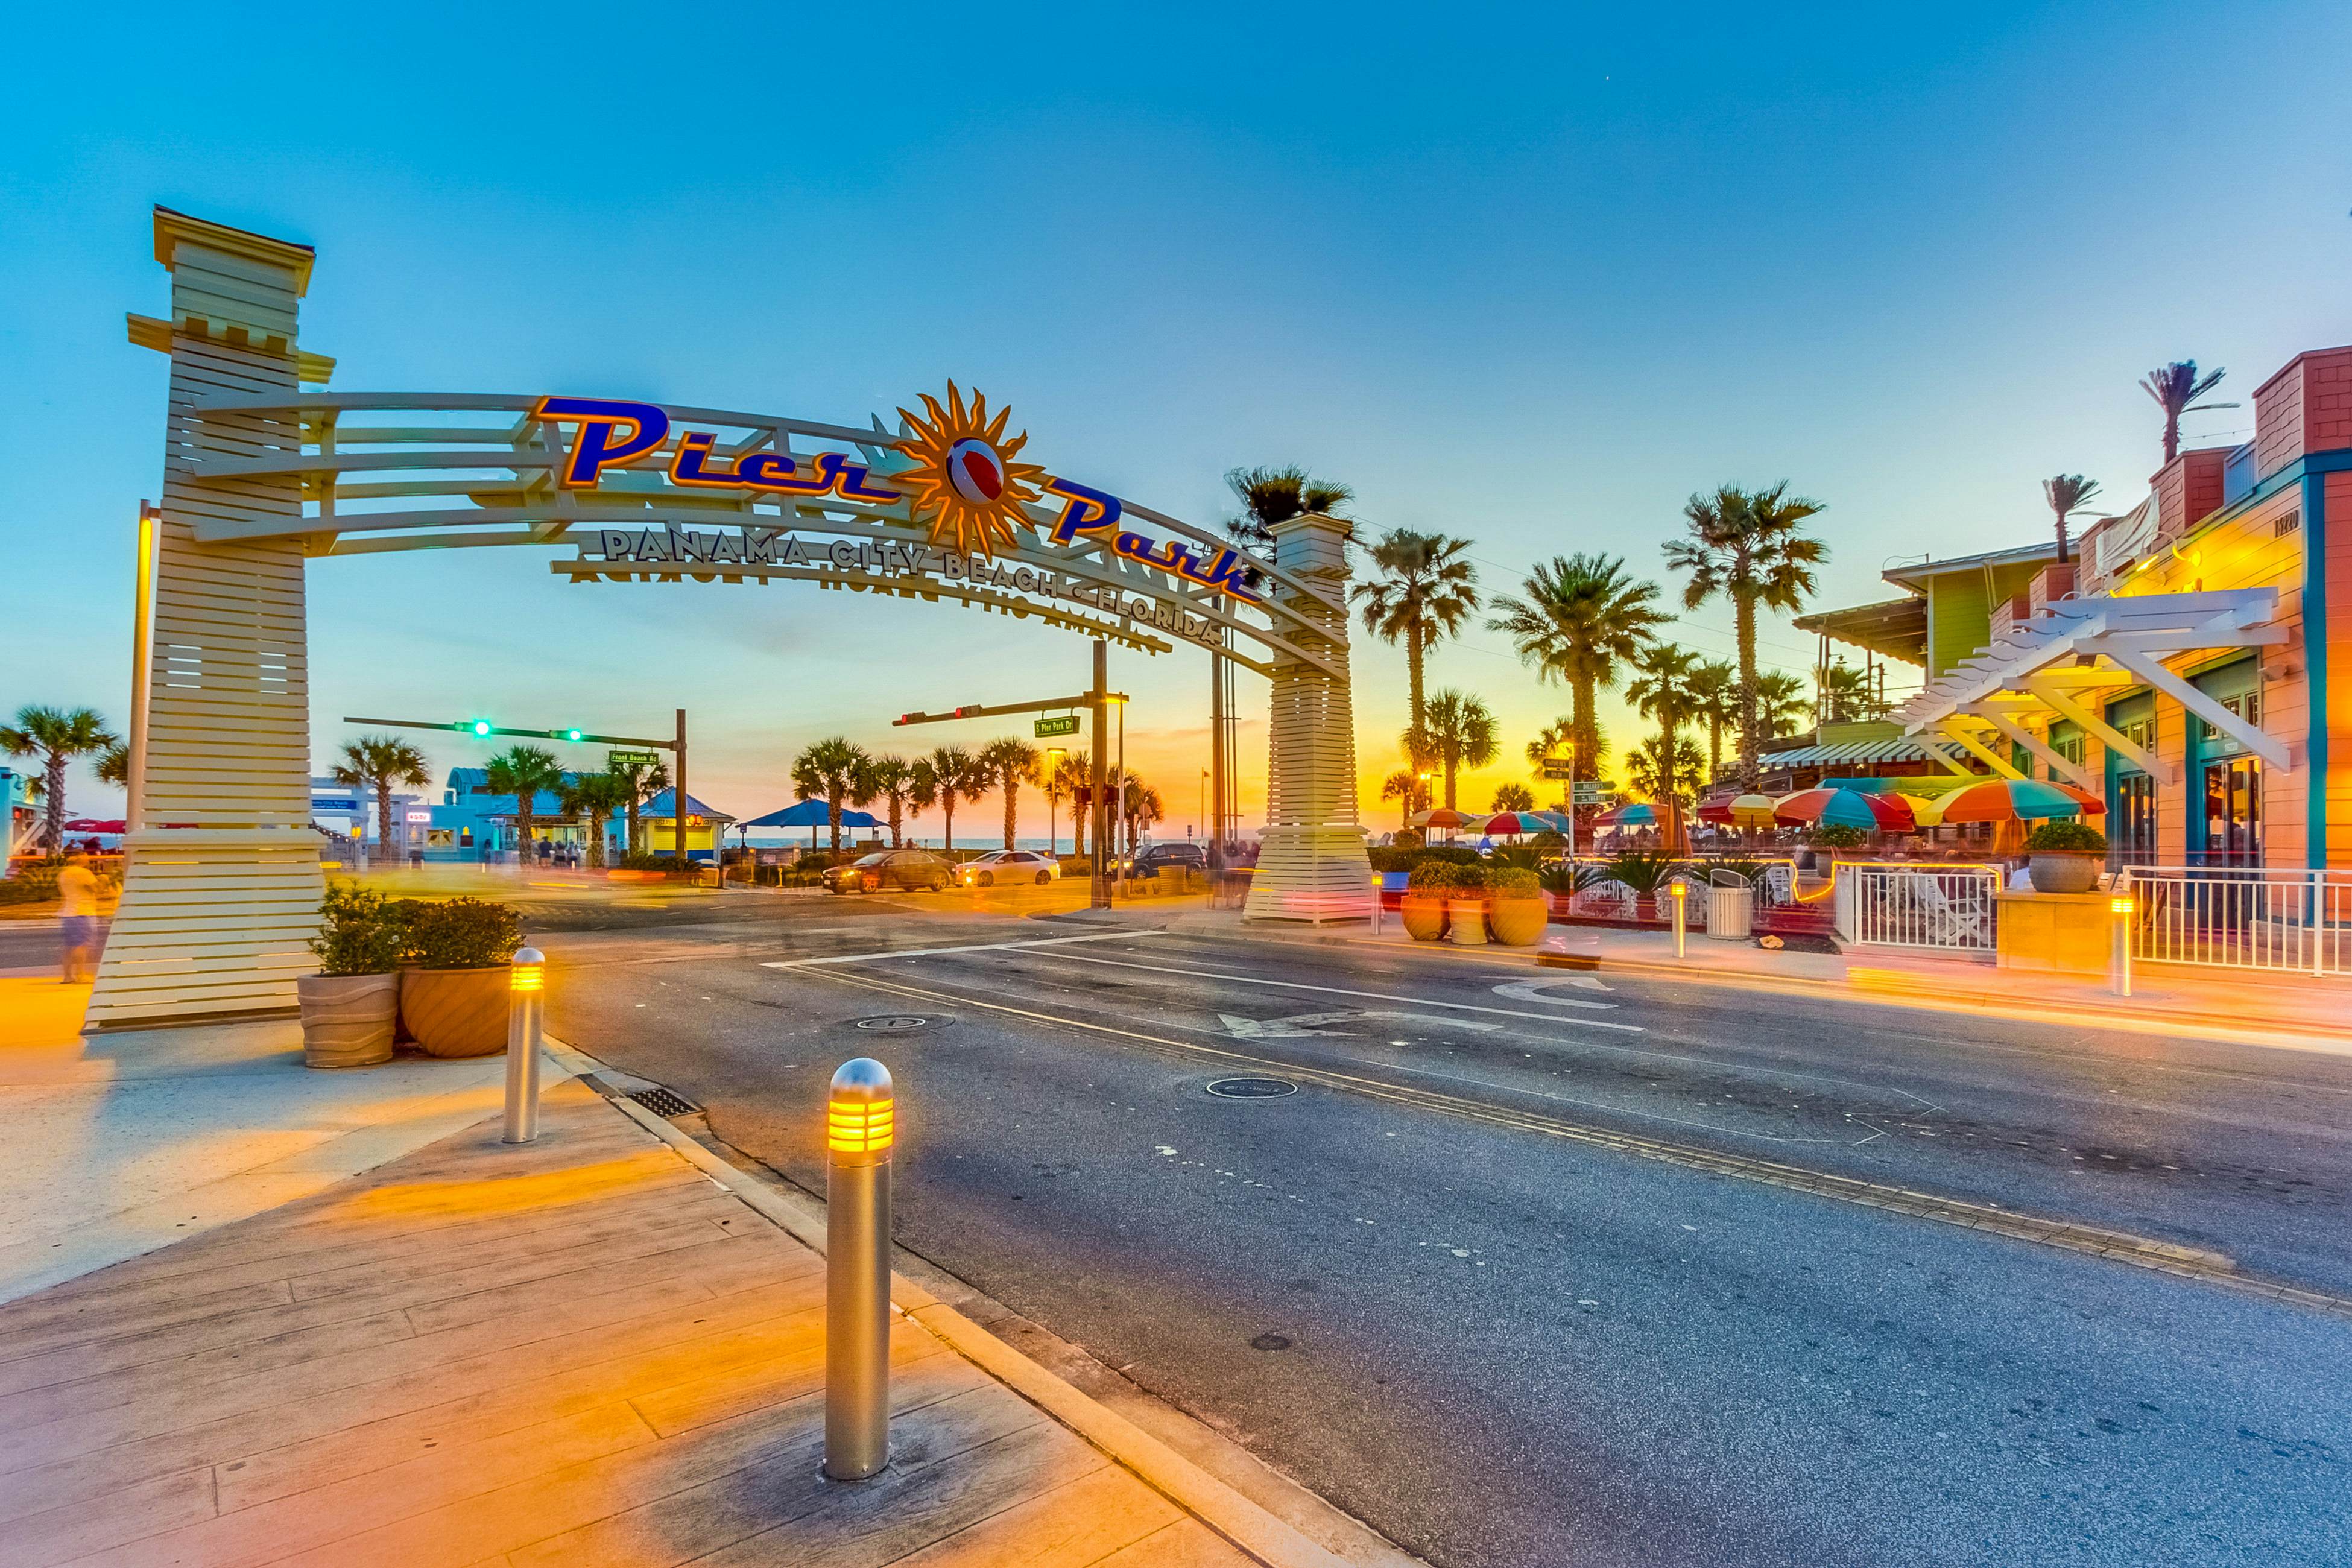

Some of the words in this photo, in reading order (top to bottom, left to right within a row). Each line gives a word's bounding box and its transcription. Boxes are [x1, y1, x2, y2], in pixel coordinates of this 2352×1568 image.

[526, 395, 902, 505] Pier
[1040, 475, 1263, 605] Park
[2275, 509, 2300, 539] 16220
[600, 526, 811, 566] PANAMA
[829, 540, 926, 575] CITY
[943, 551, 1058, 598] BEACH
[1097, 585, 1218, 646] FLORIDA
[1036, 724, 1040, 733] S
[1041, 722, 1052, 732] Pier
[1052, 721, 1064, 732] Park
[1066, 719, 1072, 730] Dr
